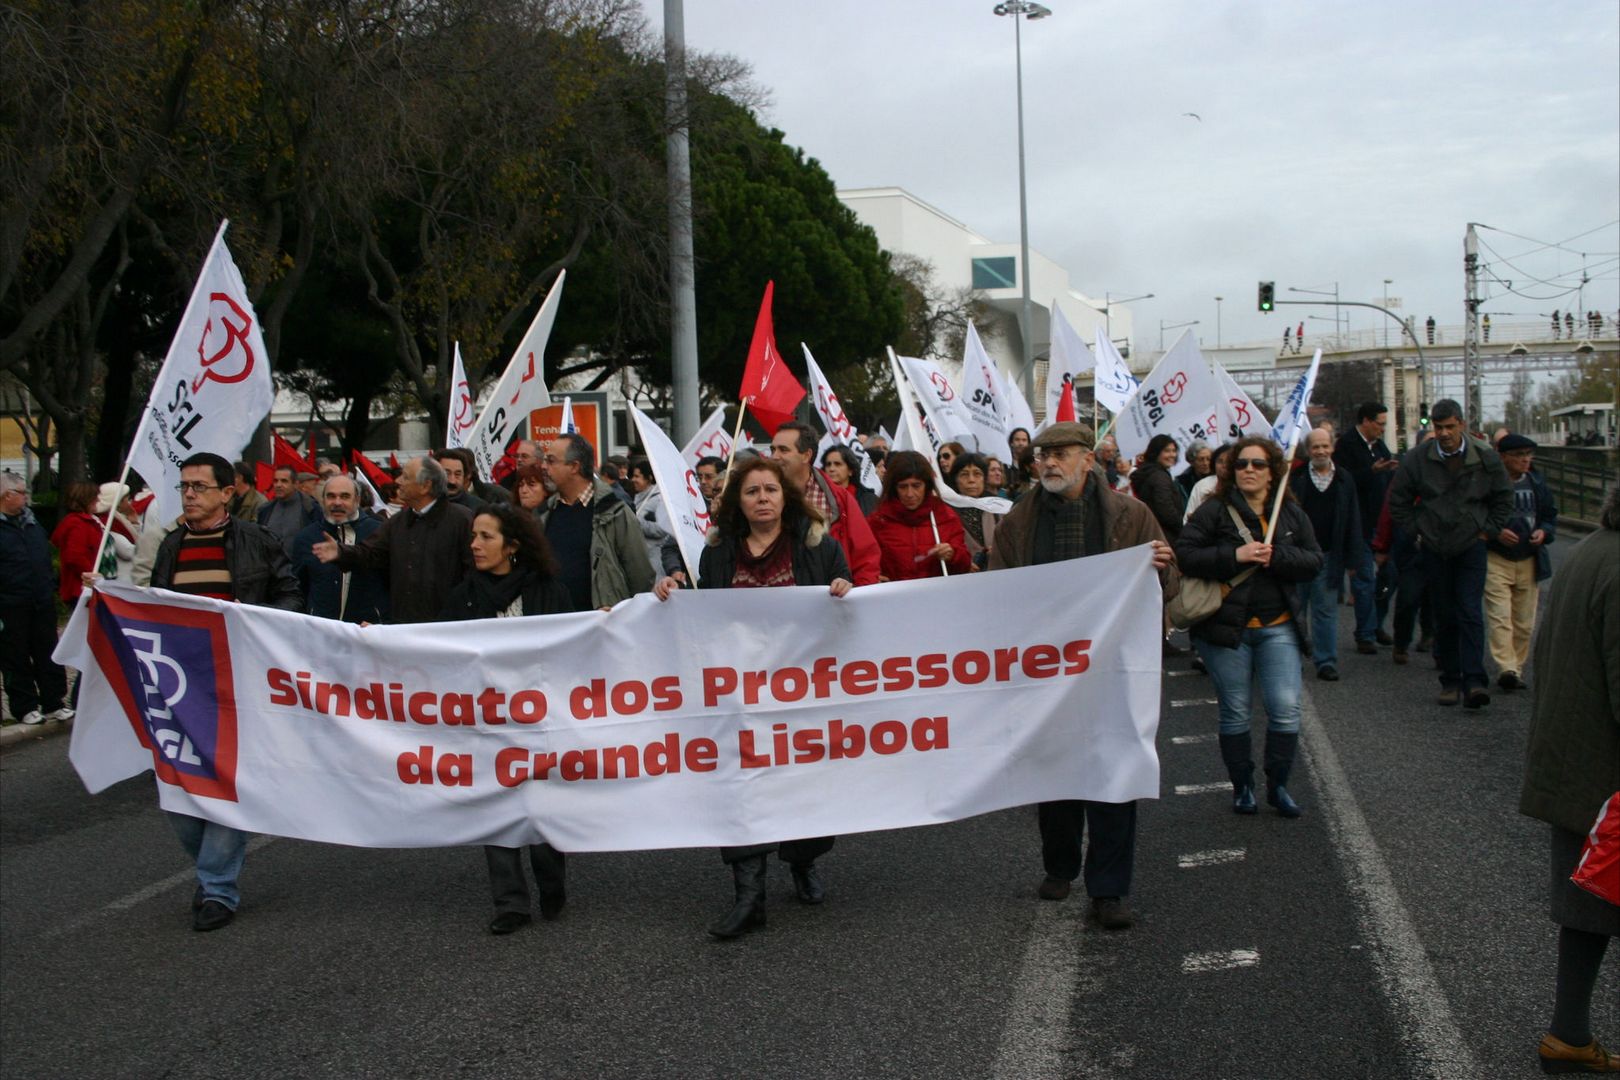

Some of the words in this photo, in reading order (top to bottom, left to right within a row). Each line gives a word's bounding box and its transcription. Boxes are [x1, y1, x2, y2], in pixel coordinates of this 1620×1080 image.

[1142, 388, 1166, 428] SPGL
[267, 668, 547, 725] Sindicato
[571, 677, 683, 720] dos
[704, 639, 1091, 707] Professores
[398, 746, 473, 787] da
[496, 733, 718, 788] Grande
[740, 717, 949, 769] Lisboa
